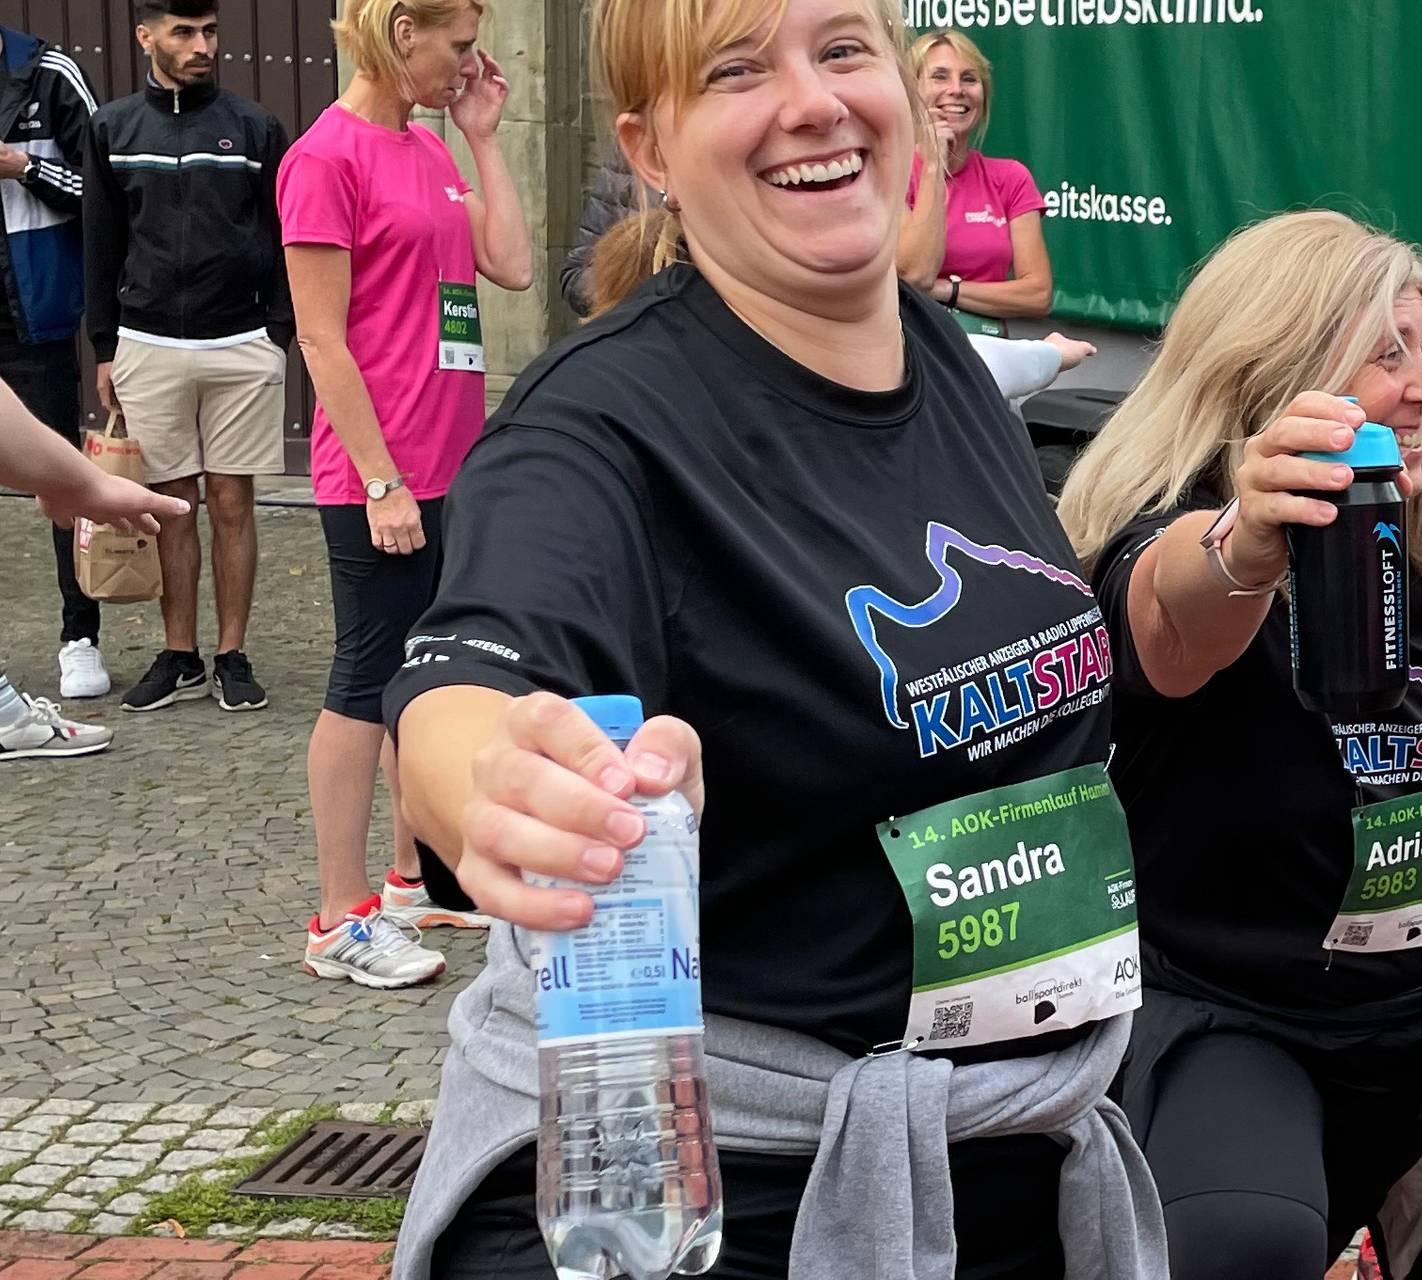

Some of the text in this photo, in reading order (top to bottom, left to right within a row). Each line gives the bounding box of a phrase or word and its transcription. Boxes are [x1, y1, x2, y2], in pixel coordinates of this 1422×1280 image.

[1044, 181, 1173, 226] eitskasse.
[443, 299, 478, 319] Kerstin
[1382, 549, 1397, 670] FITNESSLOFT
[905, 652, 990, 698] WESTFÄLISCHER
[989, 638, 1033, 666] ANZEIGER
[1038, 619, 1068, 646] RADIO
[967, 740, 993, 762] WIR
[993, 717, 1040, 753] MACHEN
[907, 825, 947, 850] 14.
[950, 787, 1078, 839] AOK-Firmenlauf
[1366, 815, 1387, 830] 14.
[926, 841, 1066, 908] Sandra
[1360, 867, 1418, 901] 5983
[937, 901, 1021, 961] 5987
